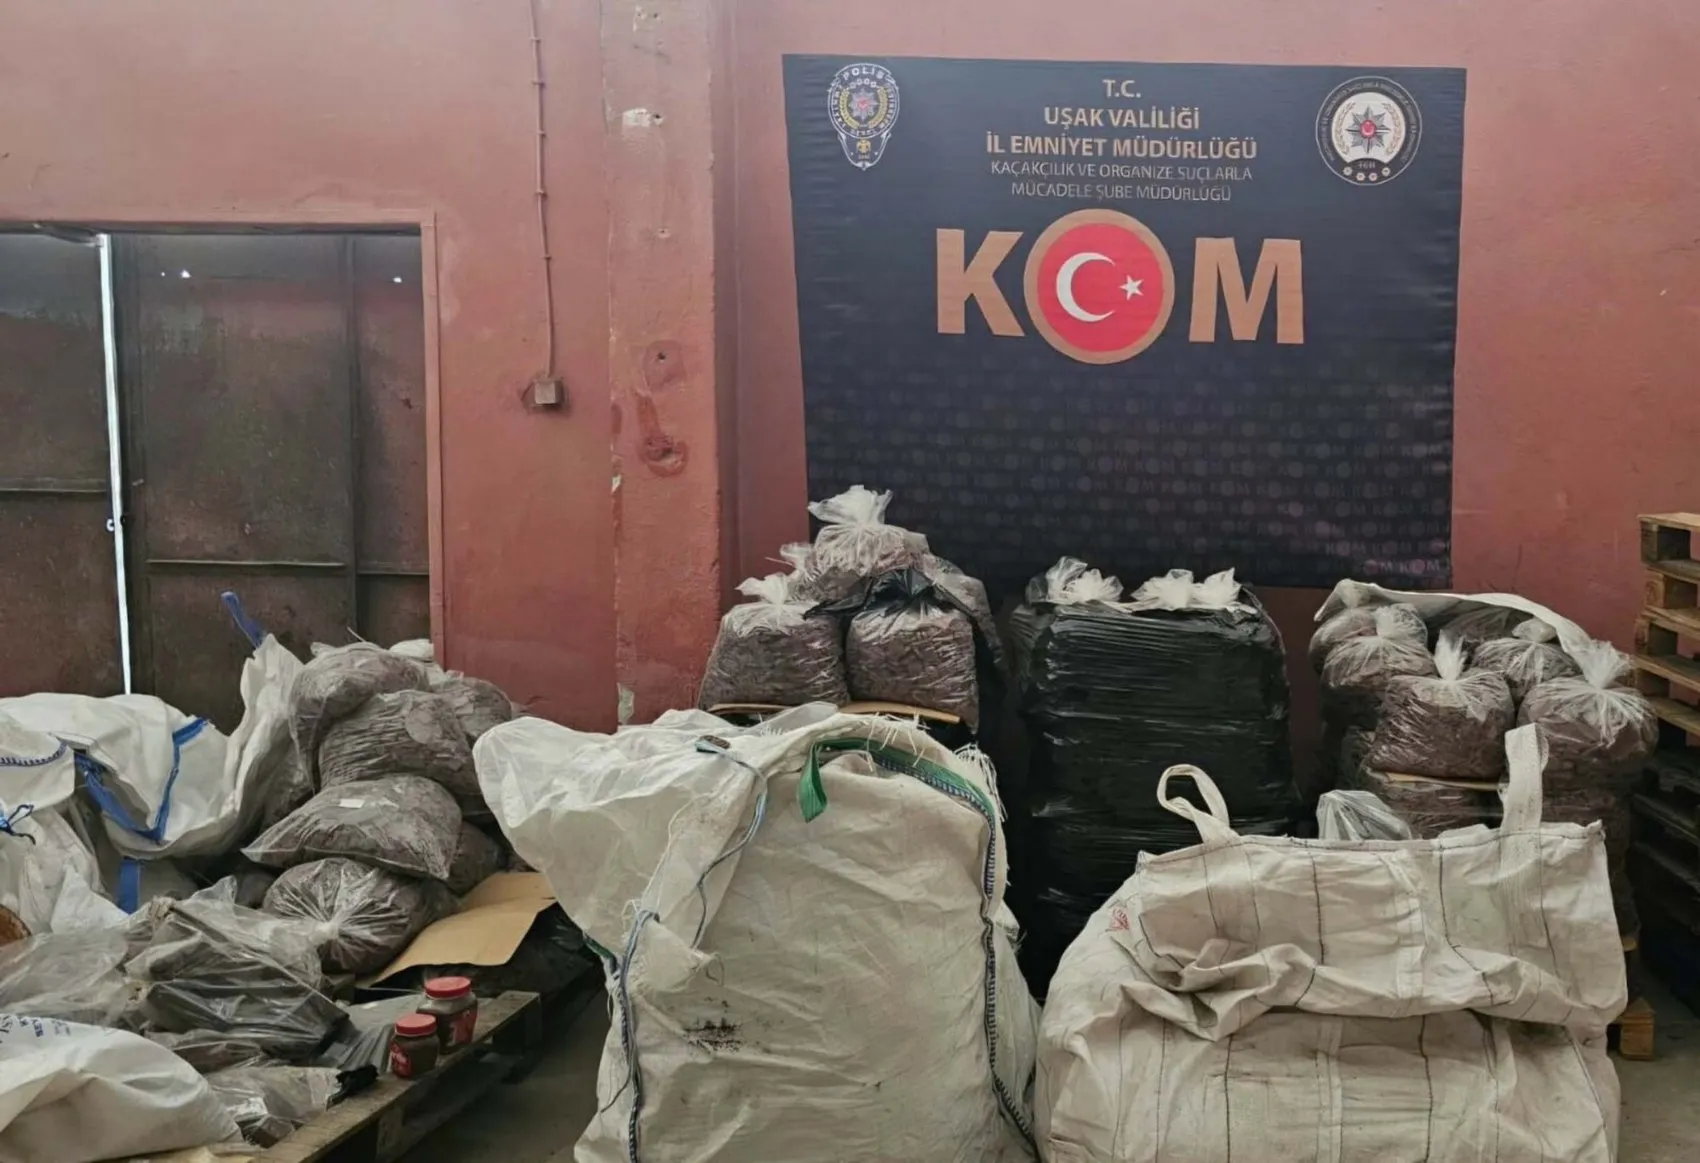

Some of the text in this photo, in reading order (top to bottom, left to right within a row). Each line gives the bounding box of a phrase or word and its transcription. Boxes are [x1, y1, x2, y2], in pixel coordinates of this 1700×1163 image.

[1102, 79, 1142, 98] T.C.
[1044, 106, 1200, 130] UŞAK VALİLİĞİ
[986, 131, 1257, 160] İL EMNİYET MÜDÜRLÜĞÜ
[991, 160, 1075, 179] KAÇAKÇILIK
[1077, 163, 1096, 177] VE
[1178, 165, 1253, 184] SUÇLARLA
[1011, 179, 1093, 198] MÜCADELE
[936, 208, 1304, 365] KOM
